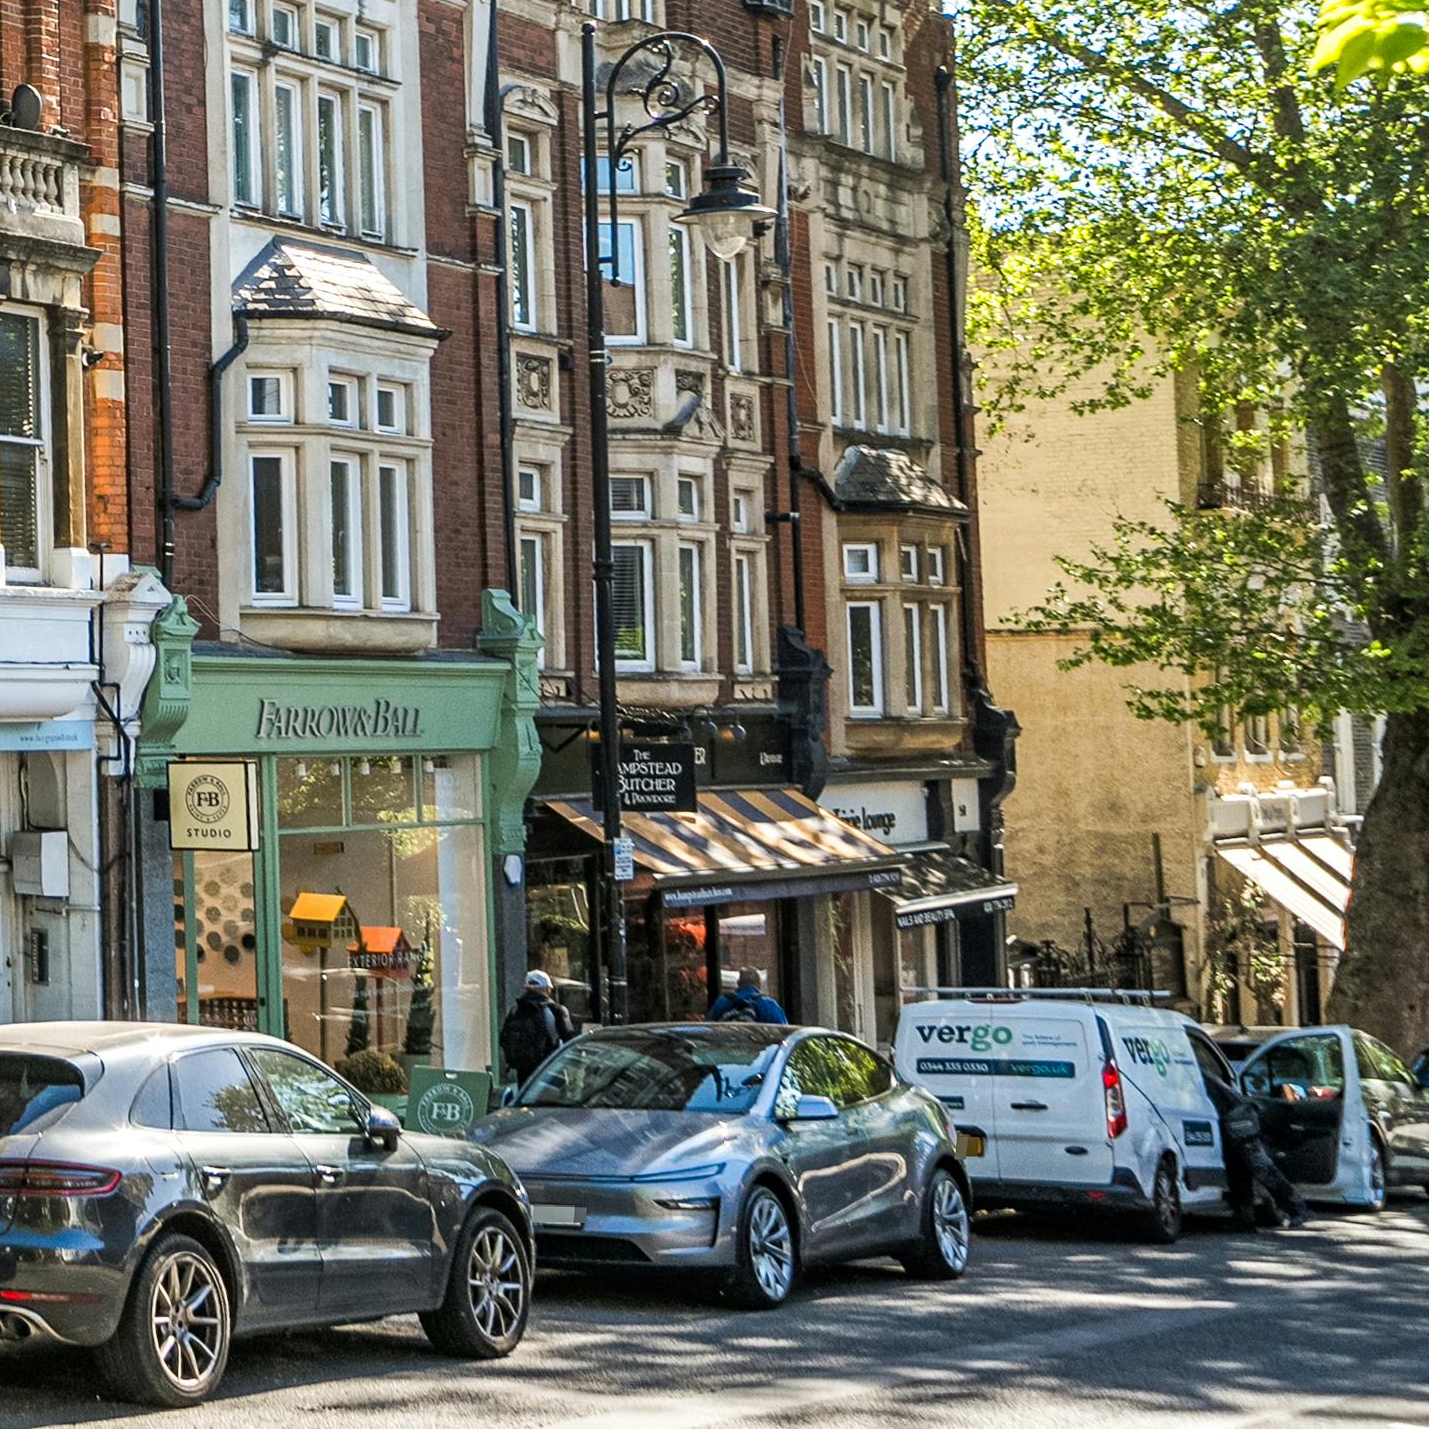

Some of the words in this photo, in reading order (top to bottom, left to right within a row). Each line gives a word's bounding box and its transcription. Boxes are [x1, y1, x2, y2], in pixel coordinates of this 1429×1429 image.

[617, 762, 683, 776] AMPSTEAD
[196, 791, 220, 807] F&B
[861, 806, 896, 836] lounge
[186, 828, 231, 838] STUDIO
[347, 953, 394, 969] EXTERIOR
[396, 950, 425, 964] RANG
[916, 1024, 1013, 1052] vergo
[1121, 1036, 1171, 1077] vergo
[431, 1102, 461, 1121] F&B
